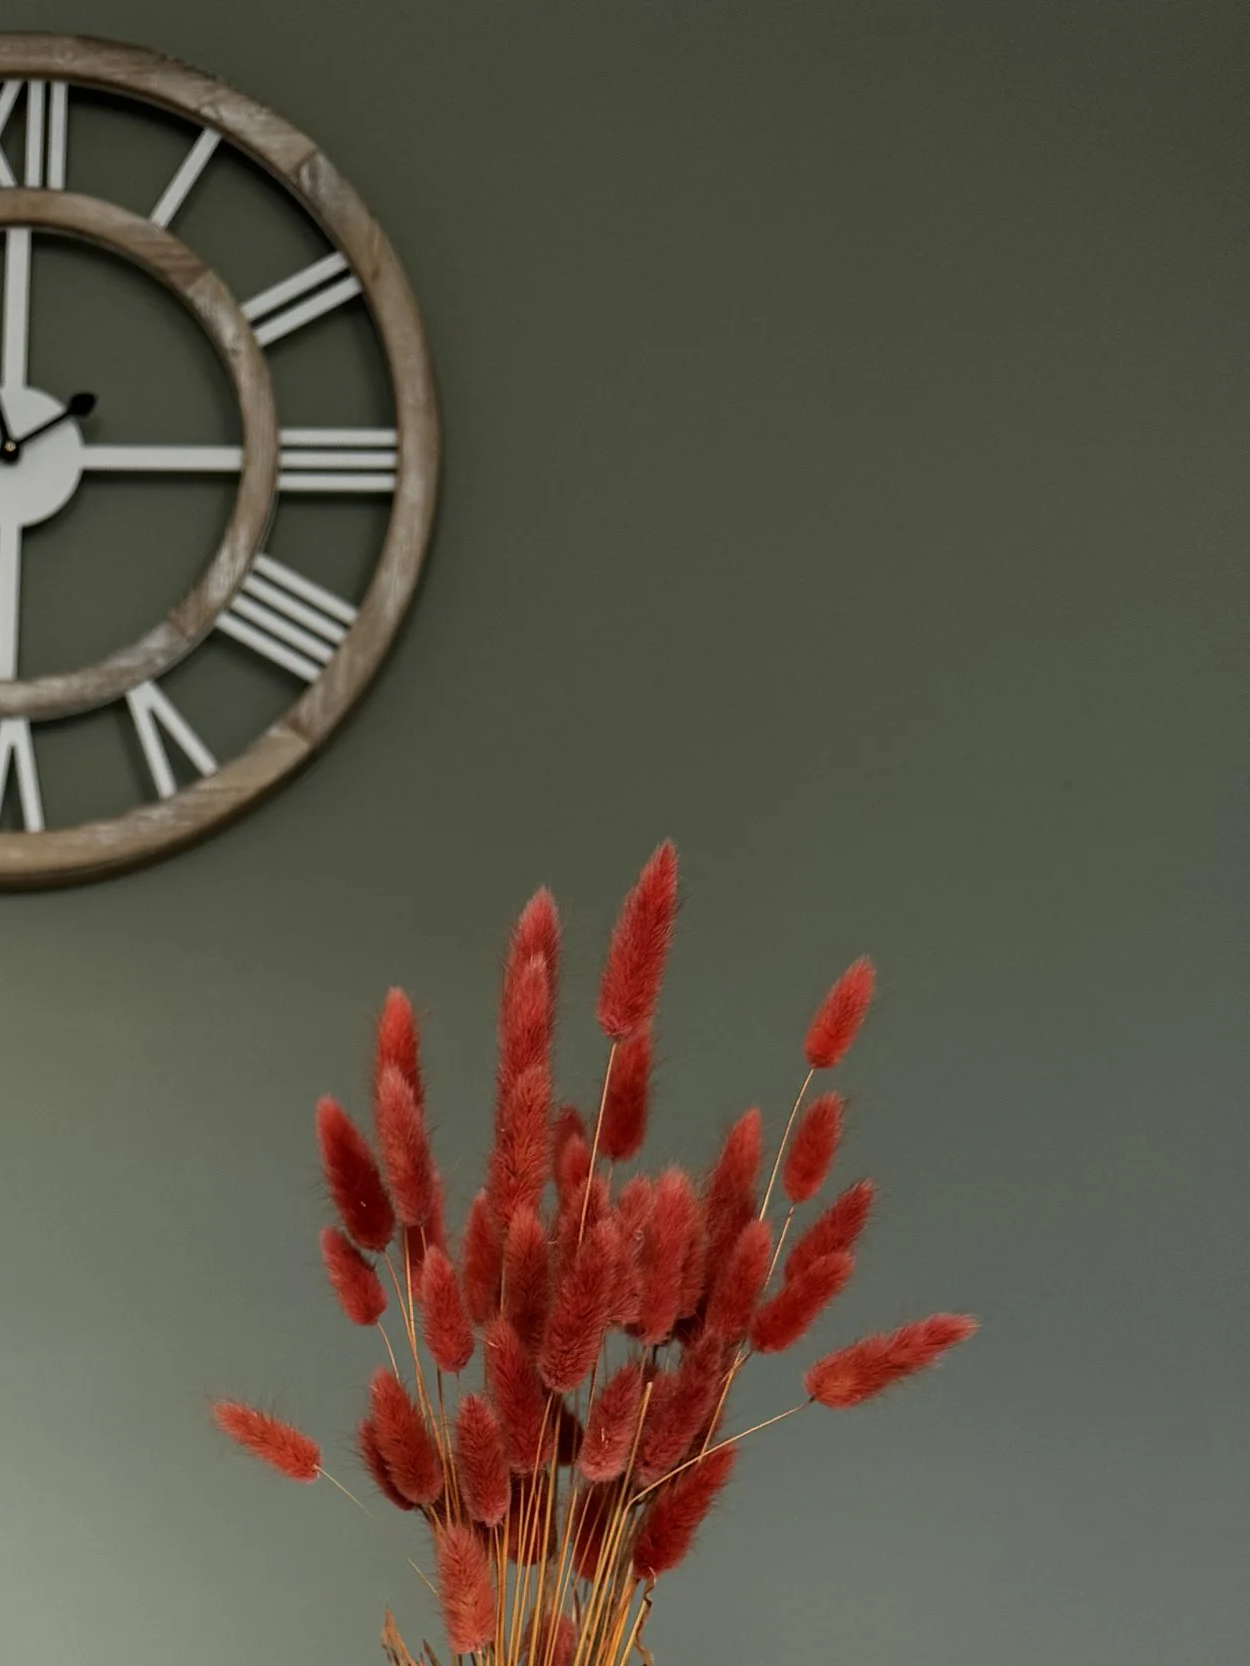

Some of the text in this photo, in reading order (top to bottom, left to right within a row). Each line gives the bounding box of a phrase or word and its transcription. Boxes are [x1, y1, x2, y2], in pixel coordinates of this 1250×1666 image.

[152, 127, 223, 229] I
[240, 251, 362, 348] II
[278, 428, 398, 492] III
[216, 553, 359, 684] IIII
[127, 680, 221, 799] V
